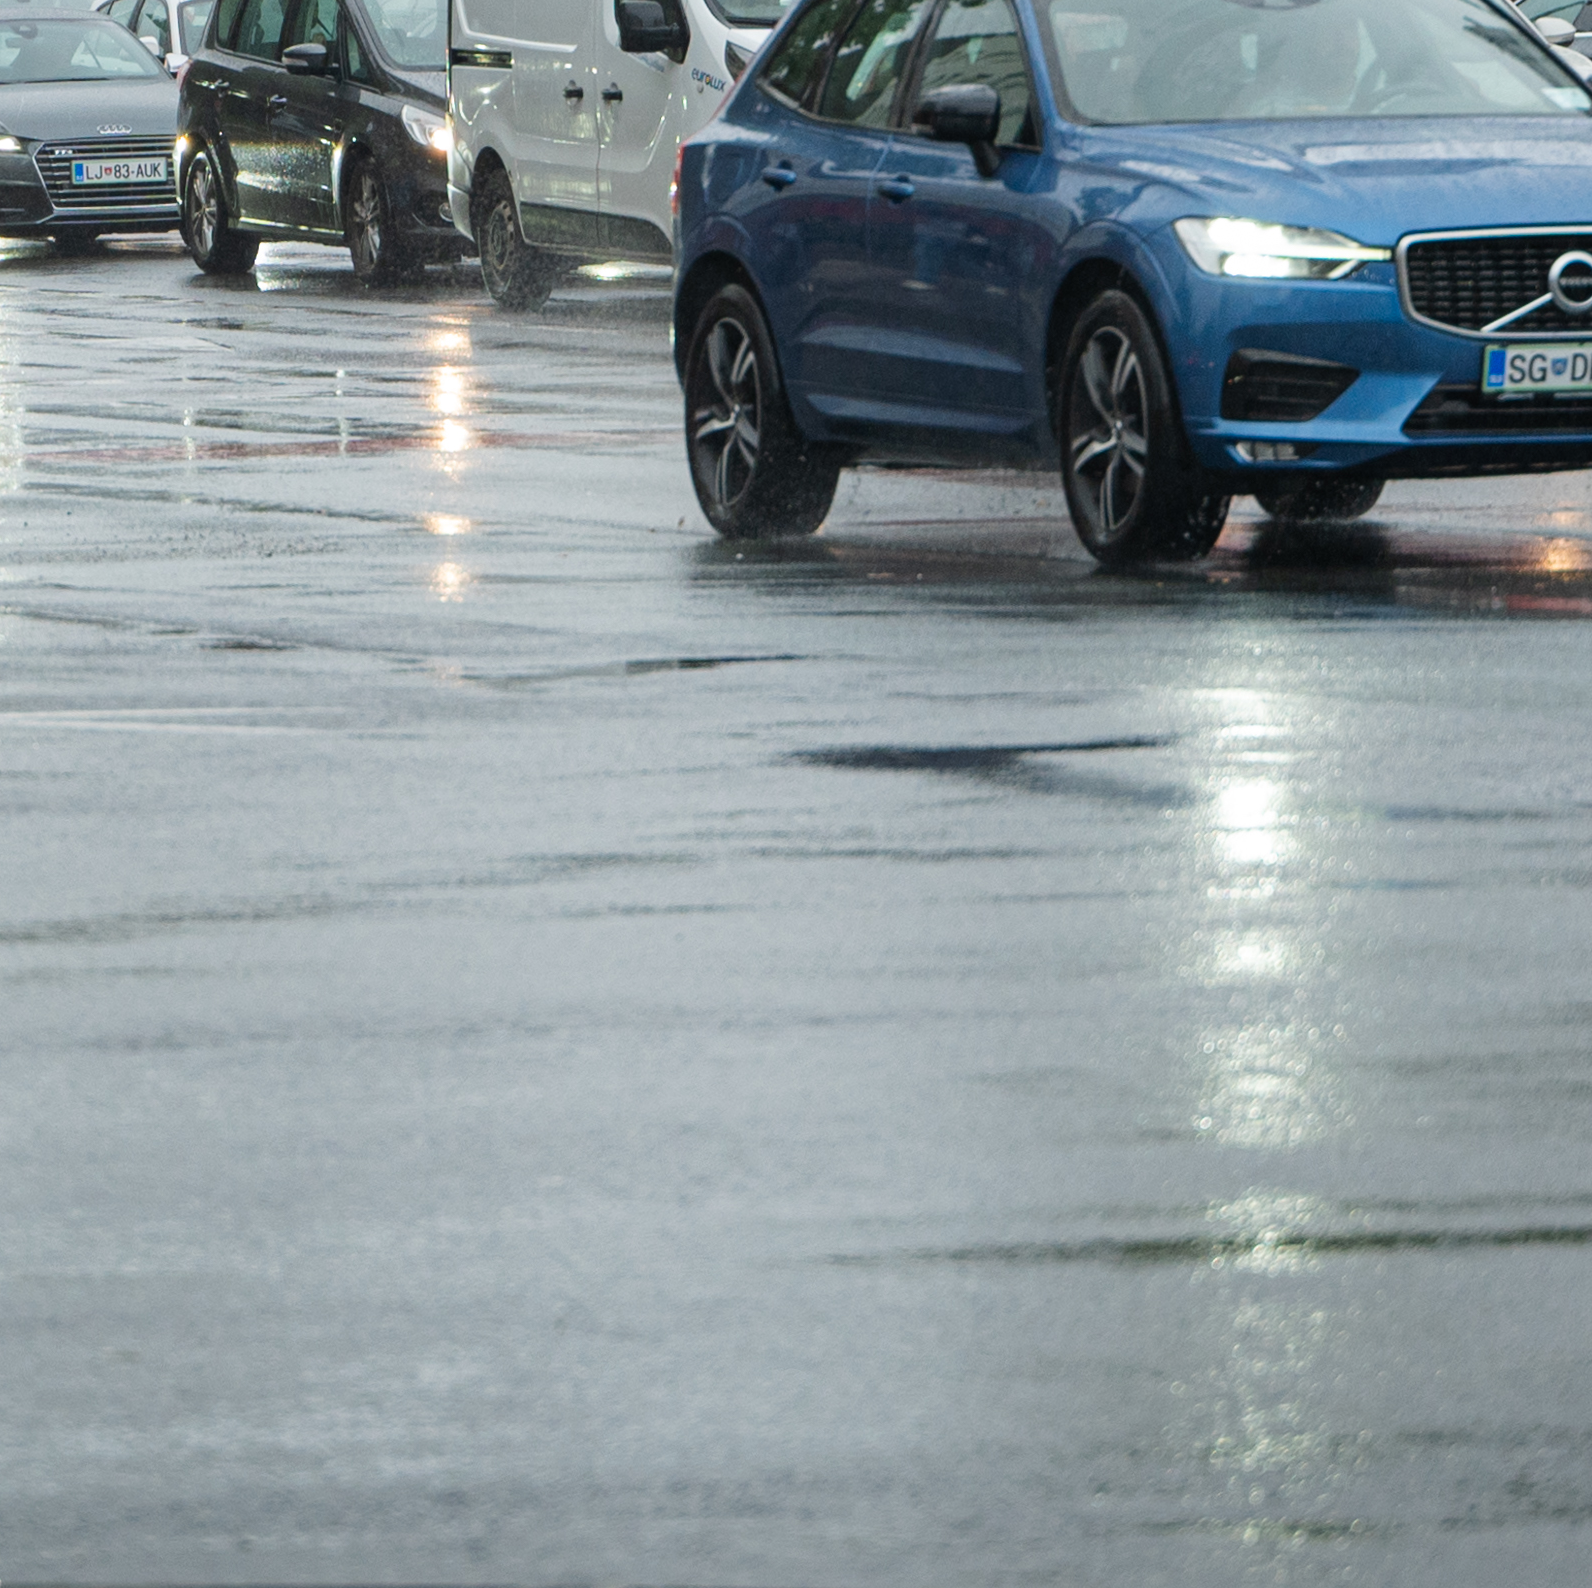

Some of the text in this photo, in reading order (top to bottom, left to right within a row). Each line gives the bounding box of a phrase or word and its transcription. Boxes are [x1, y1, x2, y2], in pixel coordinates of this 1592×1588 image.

[85, 162, 162, 181] LJ 83-AUK
[1509, 353, 1547, 384] SG
